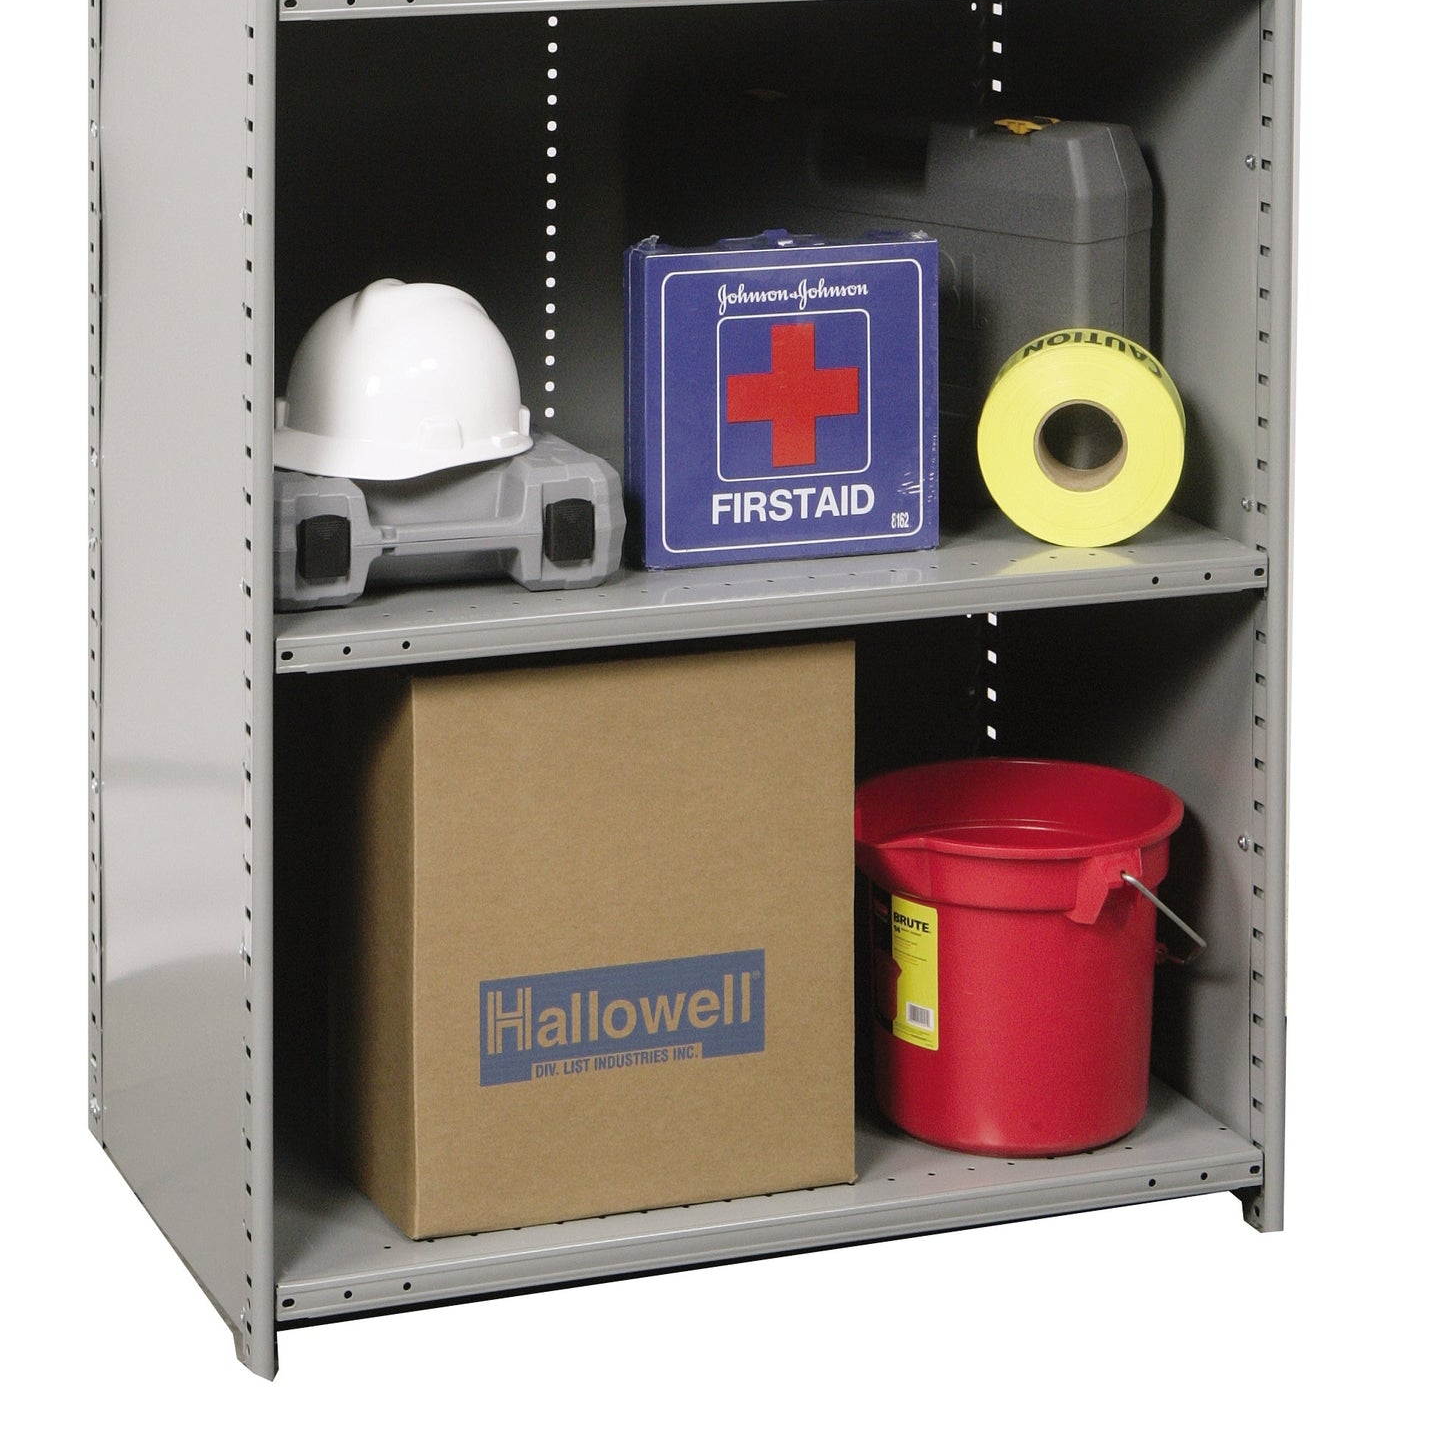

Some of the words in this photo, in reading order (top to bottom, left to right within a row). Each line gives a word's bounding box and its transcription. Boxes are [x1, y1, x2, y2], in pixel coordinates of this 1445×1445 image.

[1023, 331, 1162, 378] CAUTION
[891, 512, 909, 529] 8162
[893, 911, 930, 933] BRUTE
[535, 1062, 559, 1079] DIV.
[563, 1059, 590, 1075] LIST
[594, 1048, 668, 1071] INDUSTRIES
[673, 1046, 698, 1062] INC.
